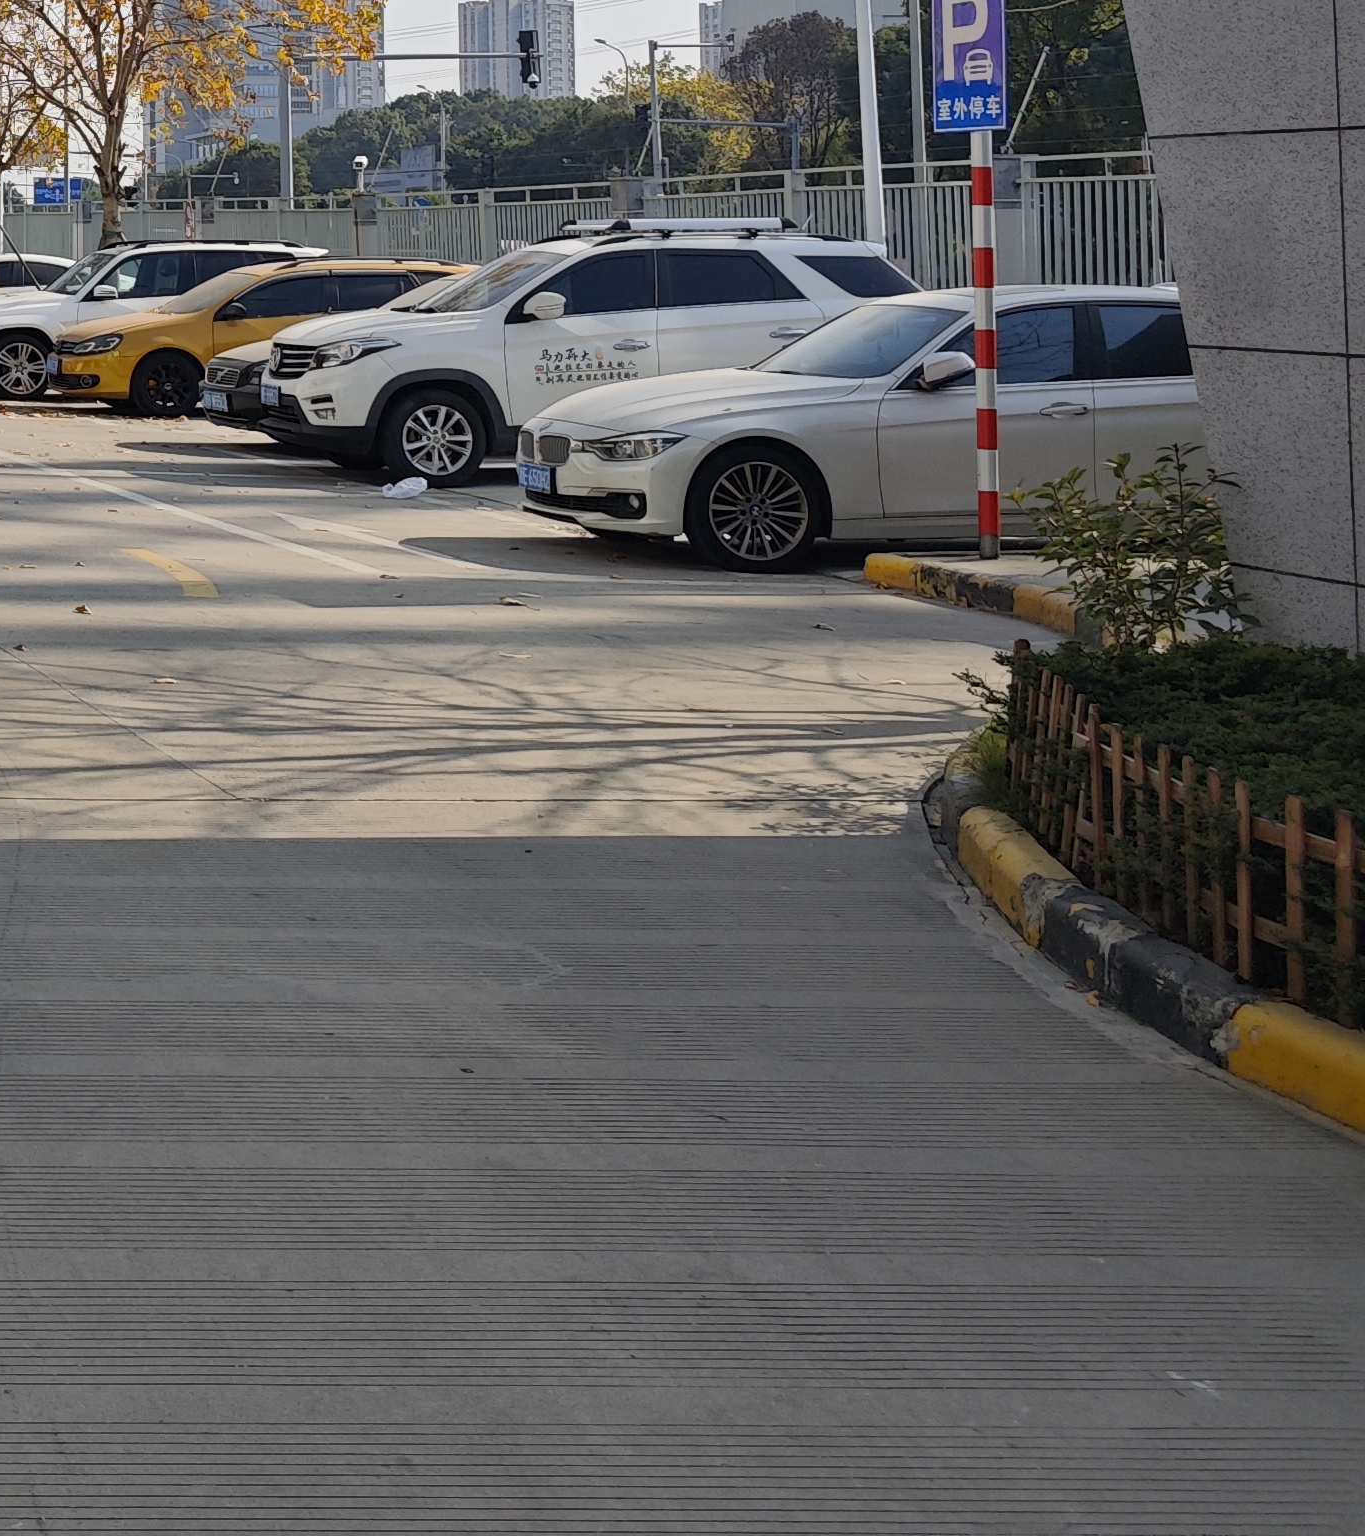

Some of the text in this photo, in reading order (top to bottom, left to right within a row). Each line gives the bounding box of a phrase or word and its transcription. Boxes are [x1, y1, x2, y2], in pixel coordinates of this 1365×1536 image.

[937, 95, 1001, 122] 室外停车
[539, 347, 592, 363] 马力再大
